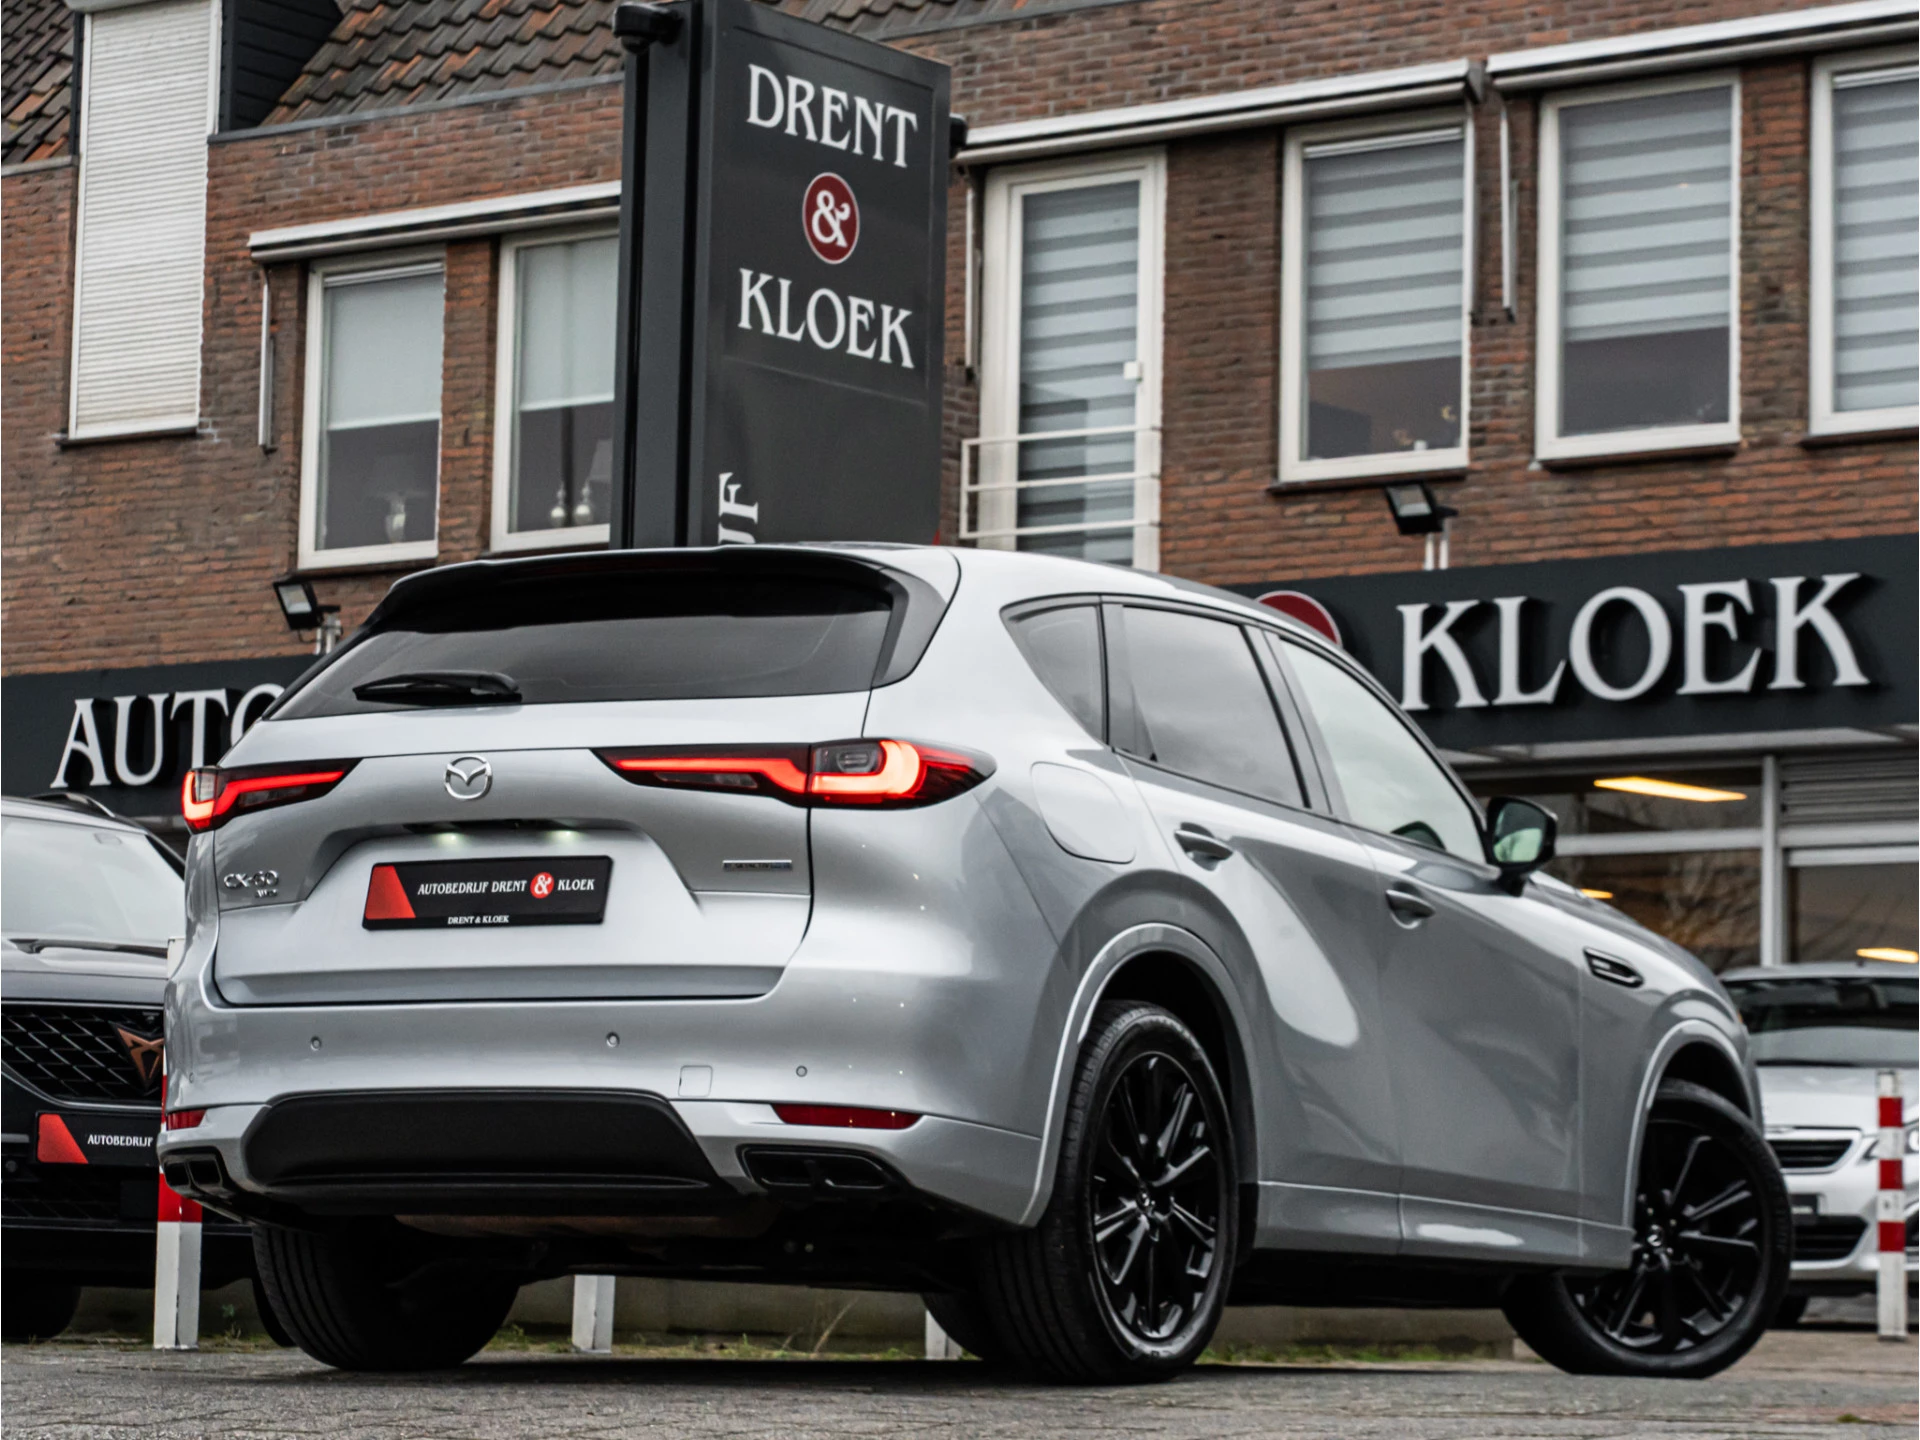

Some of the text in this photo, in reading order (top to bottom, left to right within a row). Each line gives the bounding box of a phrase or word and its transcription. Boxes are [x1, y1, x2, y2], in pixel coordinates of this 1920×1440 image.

[746, 64, 917, 168] DRENT
[811, 189, 851, 248] &
[737, 268, 915, 369] KLOEK
[1396, 572, 1870, 711] KLOEK
[223, 869, 279, 888] CX-60
[417, 874, 595, 896] AUTOBEDRIJF DRENT & KLOEK
[447, 914, 509, 925] DRENT & KLOEK
[87, 1133, 153, 1147] AUTOBEDRIJF
